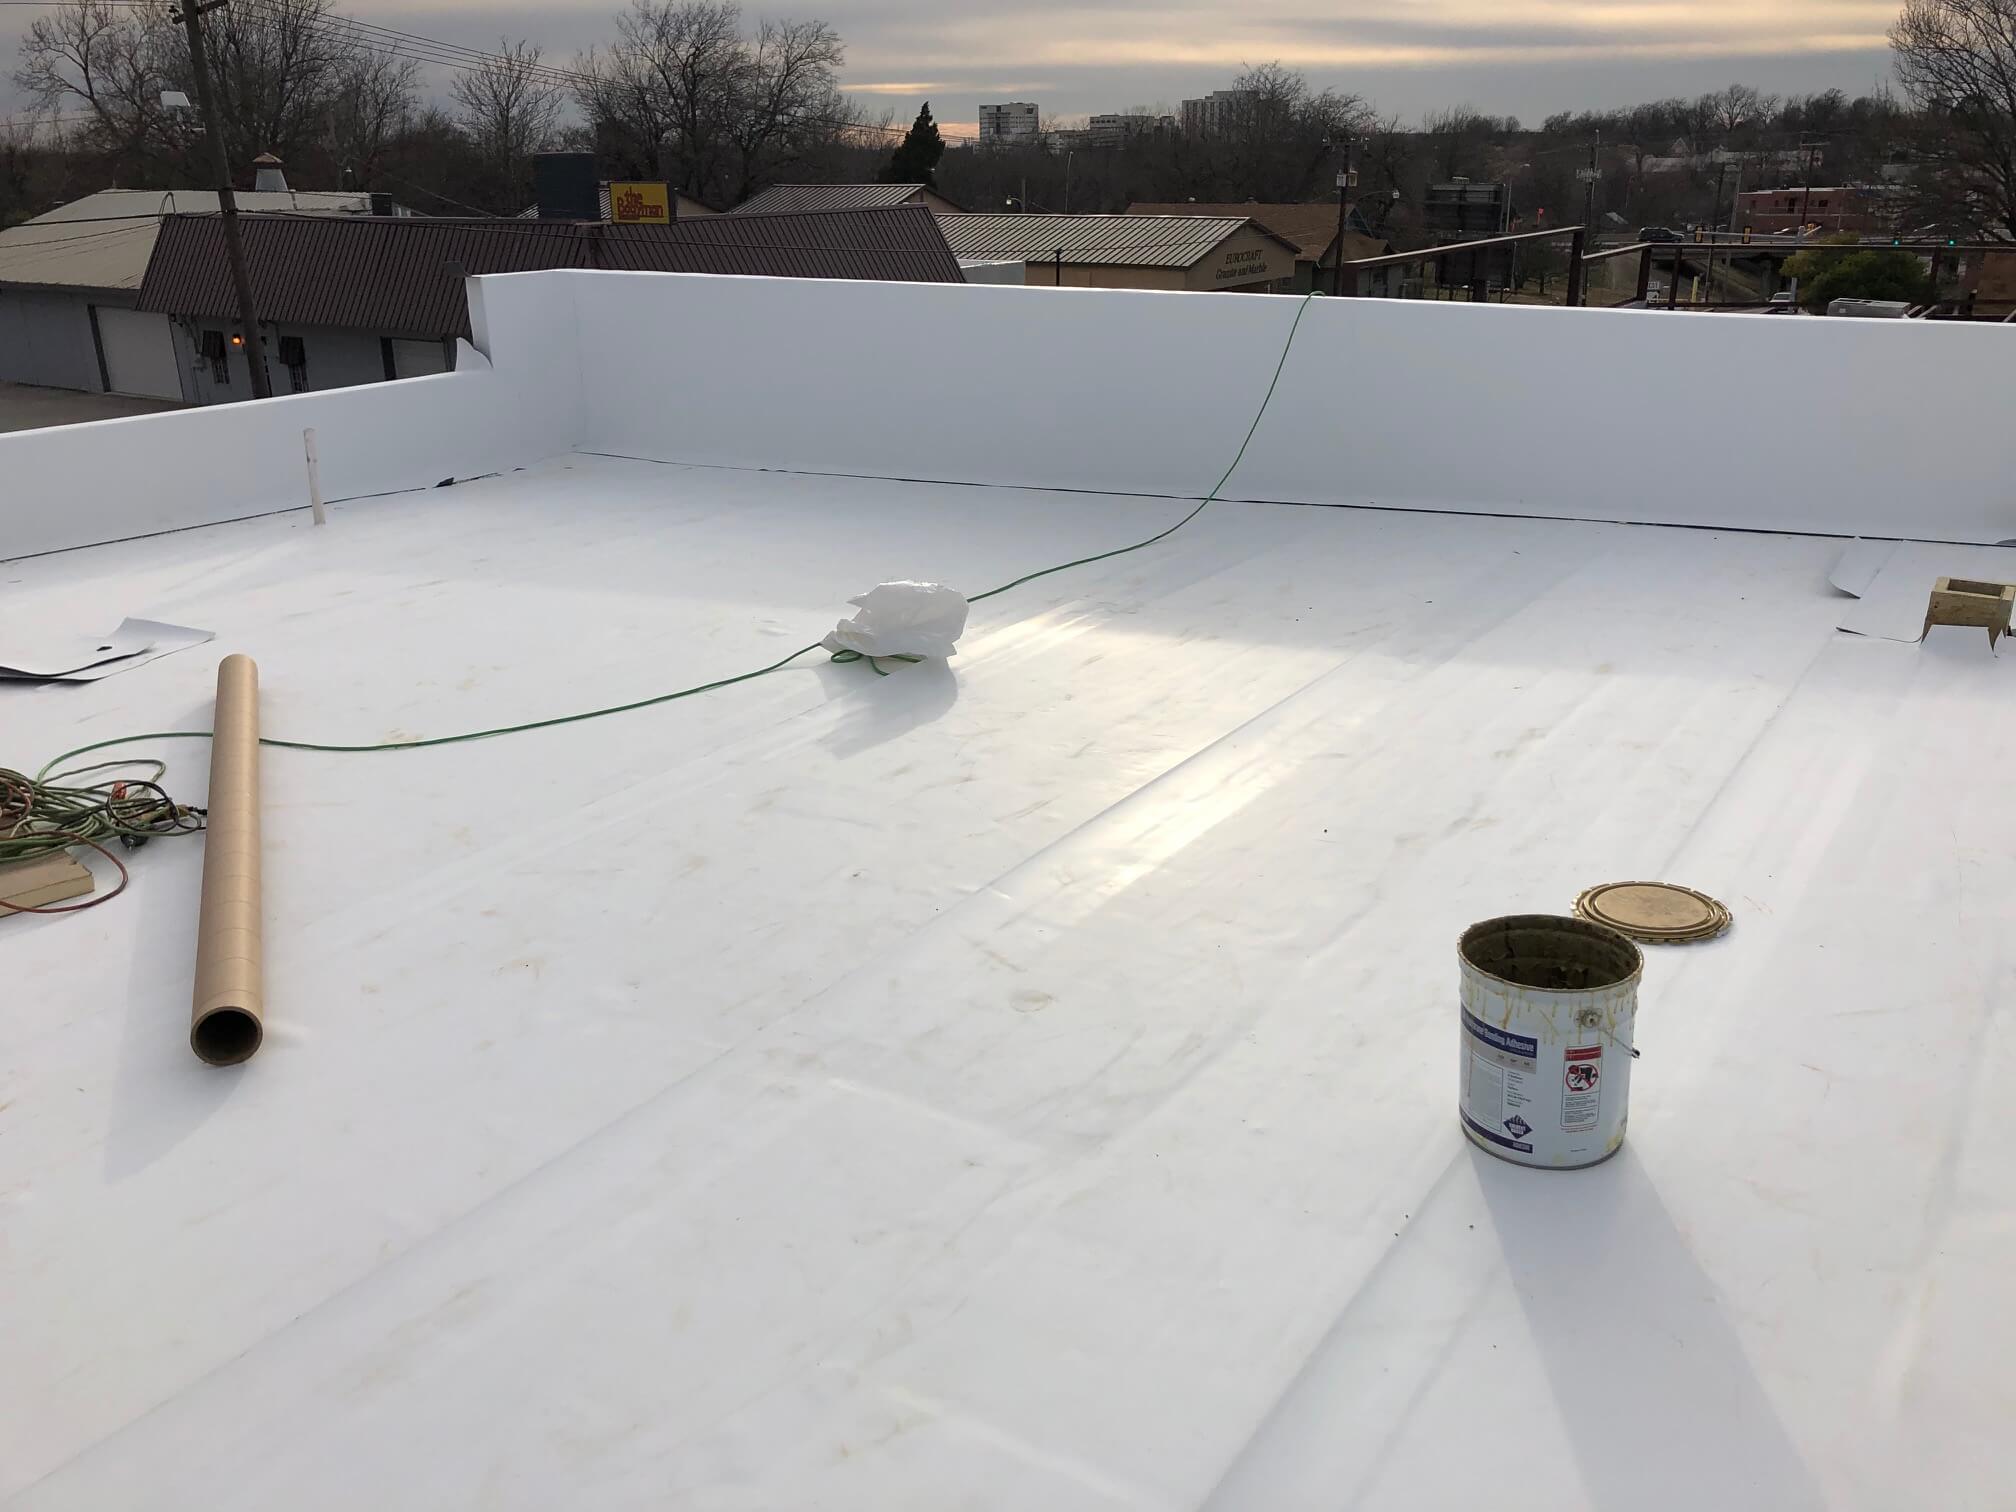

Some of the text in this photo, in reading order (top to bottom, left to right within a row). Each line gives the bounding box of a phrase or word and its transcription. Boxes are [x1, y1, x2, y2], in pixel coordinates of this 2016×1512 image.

[1226, 249, 1263, 264] EUROCRAFT
[1216, 263, 1267, 280] Granite and Marble
[1506, 1037, 1534, 1052] Adhesive
